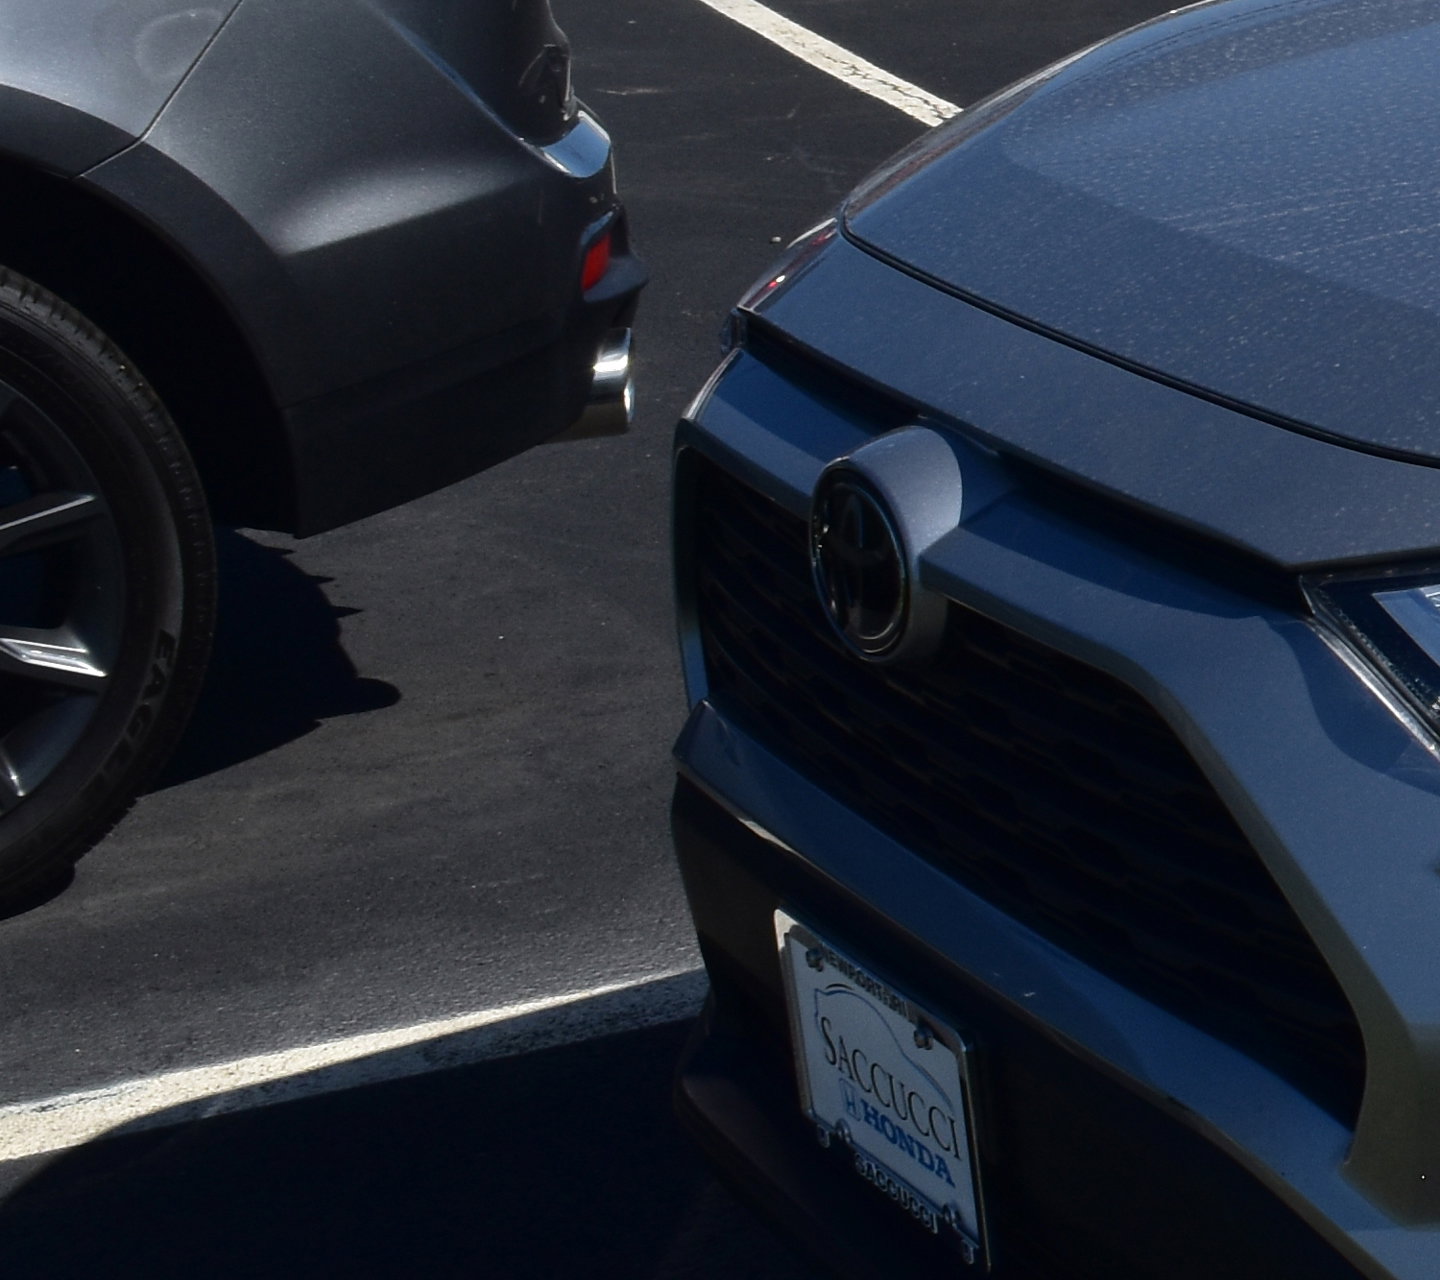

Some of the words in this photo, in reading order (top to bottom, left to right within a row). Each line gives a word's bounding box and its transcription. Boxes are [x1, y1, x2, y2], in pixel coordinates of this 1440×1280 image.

[819, 1016, 962, 1160] SACCUCCI
[860, 1097, 956, 1189] HONDA
[853, 1151, 940, 1235] SACCUCCI
